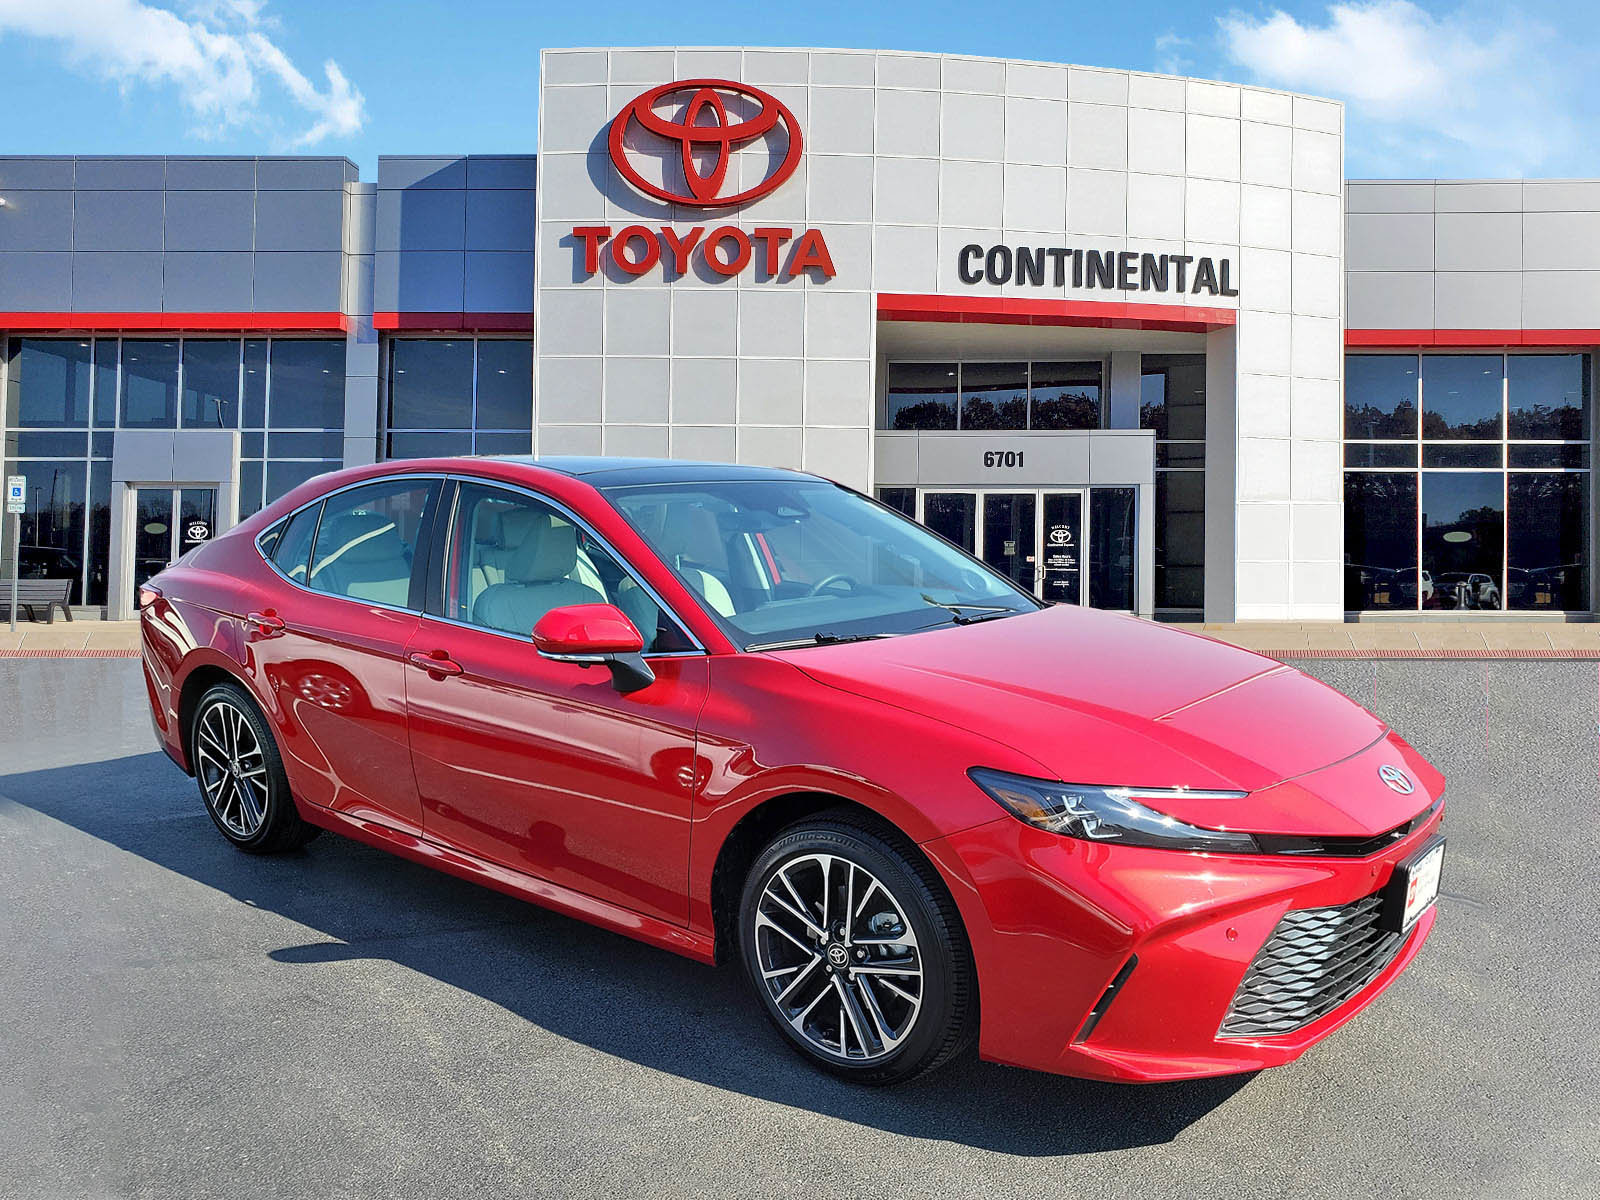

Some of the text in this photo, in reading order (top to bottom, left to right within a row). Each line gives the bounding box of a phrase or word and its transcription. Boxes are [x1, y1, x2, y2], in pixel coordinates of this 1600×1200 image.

[572, 225, 837, 278] TOYOTA
[958, 243, 1239, 297] CONTINENTAL
[983, 450, 1024, 468] 6701
